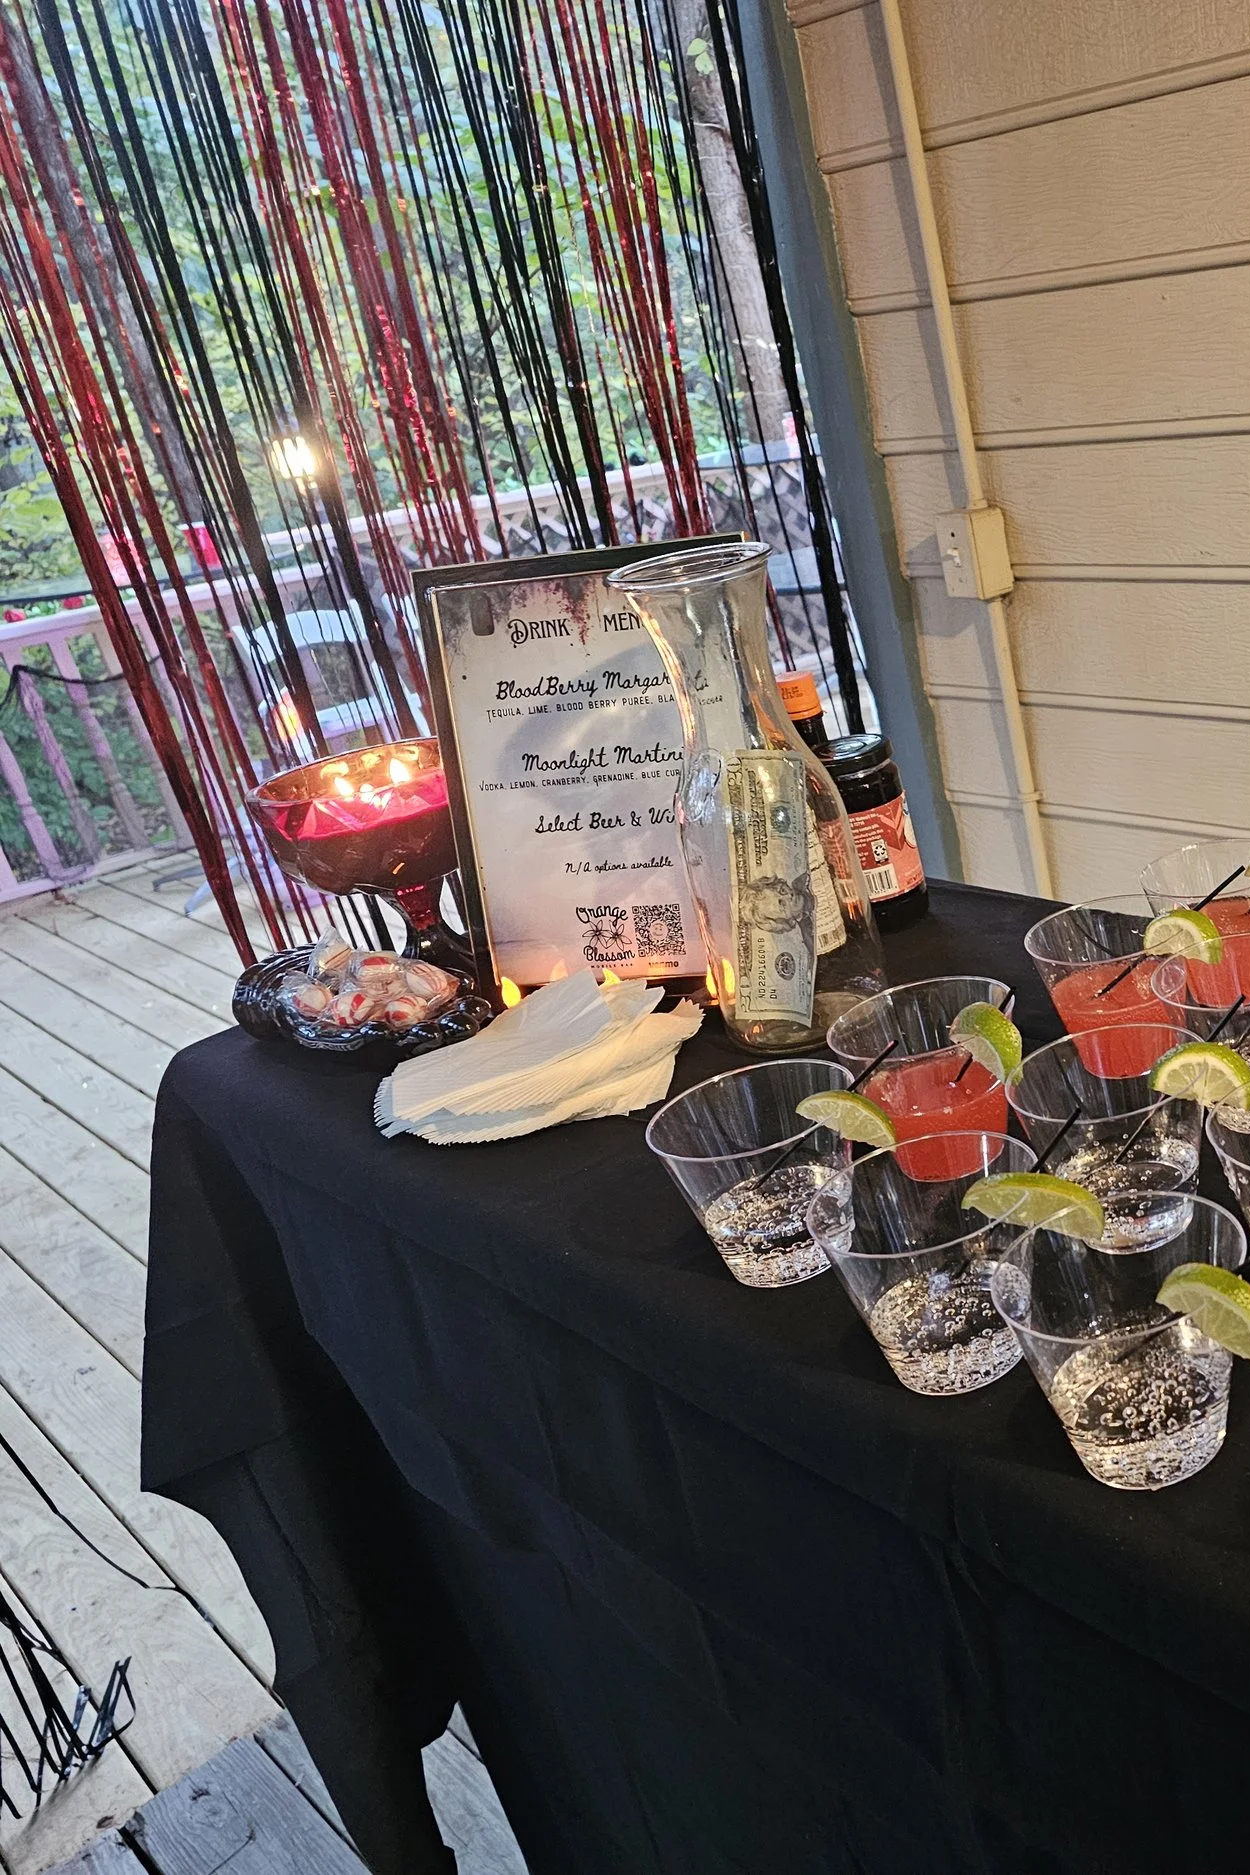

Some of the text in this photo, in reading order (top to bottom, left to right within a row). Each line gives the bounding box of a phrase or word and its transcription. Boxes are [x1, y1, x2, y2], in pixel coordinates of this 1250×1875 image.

[508, 618, 571, 645] DRINK
[496, 670, 709, 701] BloodBerry Margarta
[556, 702, 584, 712] BLOOD
[588, 699, 617, 710] BERRY
[521, 742, 685, 775] Moonlight Martini
[641, 770, 661, 780] BLUE
[535, 807, 676, 834] Select Beer & Wi
[594, 860, 628, 874] options
[630, 856, 674, 869] available
[575, 905, 629, 927] Orange
[583, 945, 636, 962] Blossom
